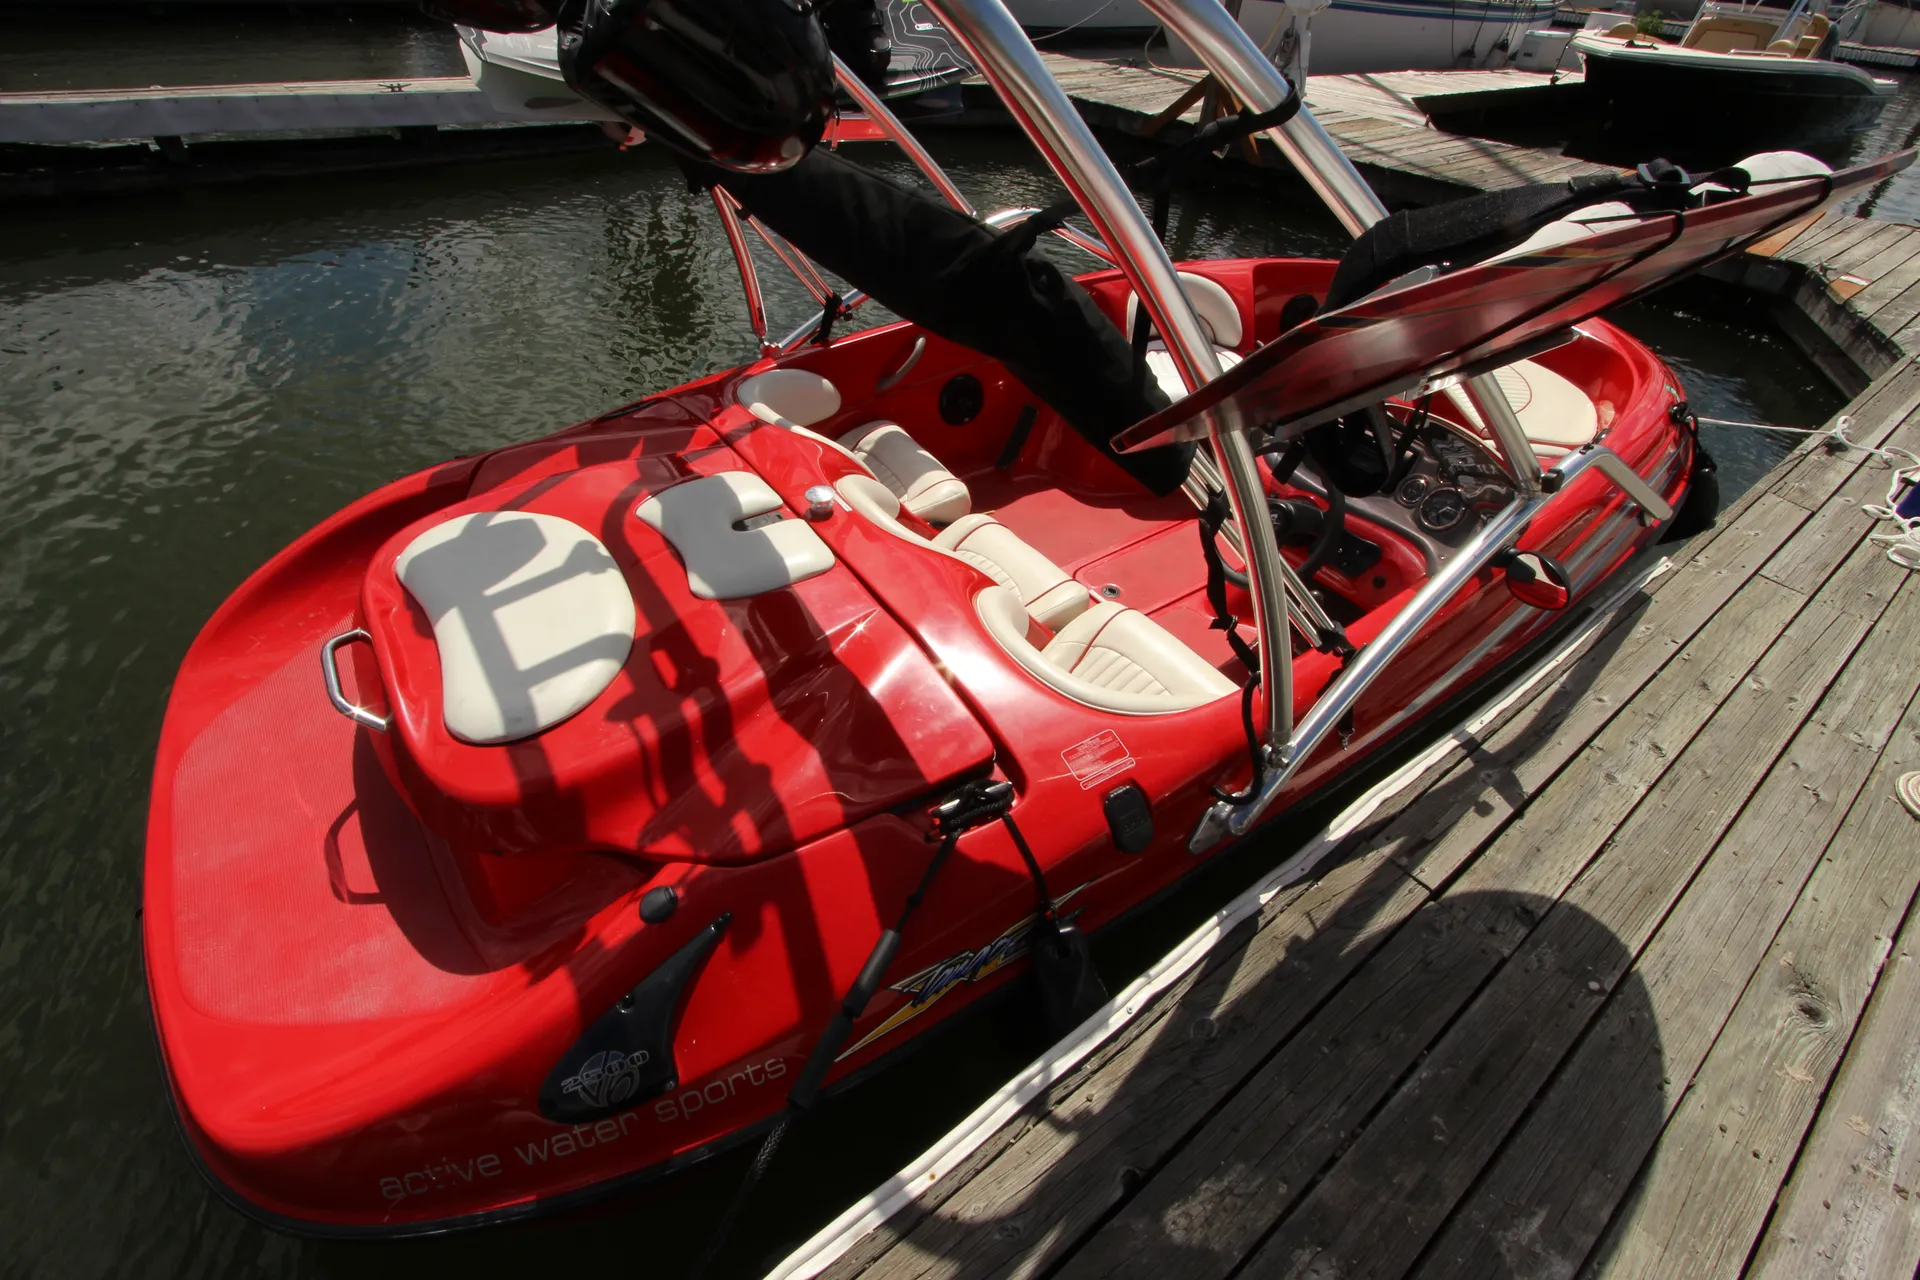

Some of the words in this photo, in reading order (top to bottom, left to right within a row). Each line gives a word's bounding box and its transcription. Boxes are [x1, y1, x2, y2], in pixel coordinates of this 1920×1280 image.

[560, 1050, 650, 1094] 2500
[378, 1153, 503, 1201] active
[513, 1111, 640, 1167] water
[654, 1057, 788, 1124] sports
